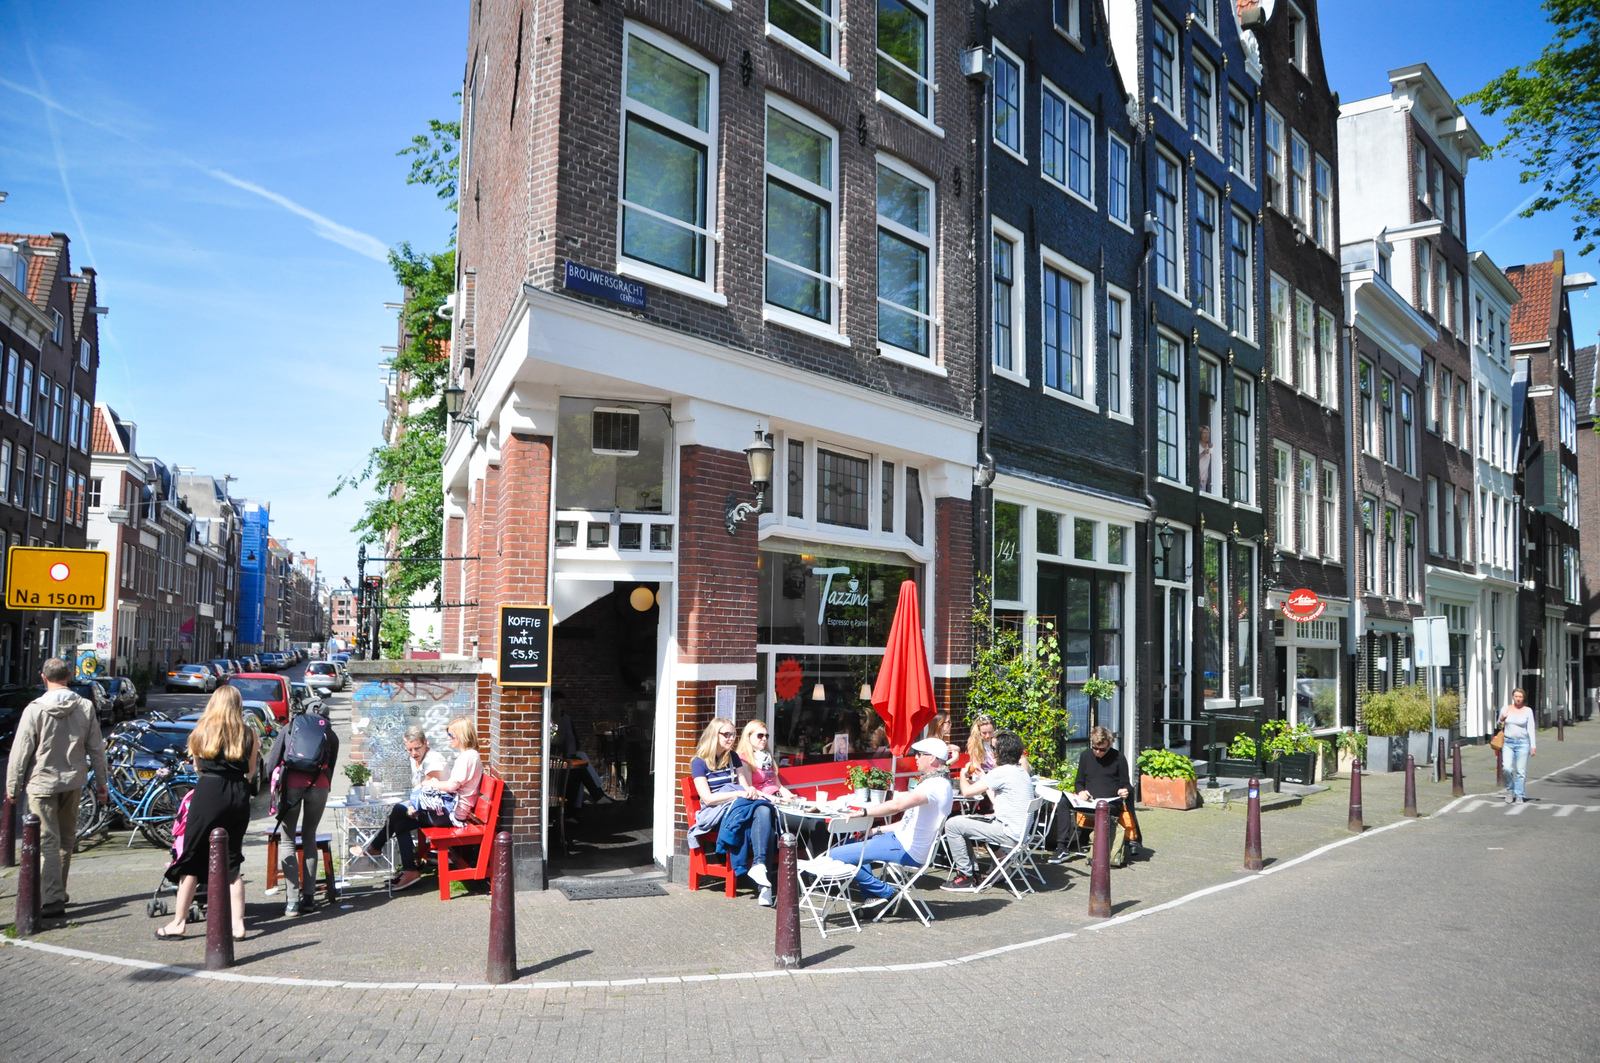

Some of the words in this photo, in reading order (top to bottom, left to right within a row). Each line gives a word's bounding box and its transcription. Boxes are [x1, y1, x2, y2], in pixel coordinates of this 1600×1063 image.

[568, 264, 644, 297] BROUWERSGRACHT
[619, 292, 644, 305] CENTRUM
[15, 589, 40, 604] Na
[812, 566, 869, 626] Tazzina
[507, 615, 541, 628] KOFFIE
[508, 635, 533, 646] TAART
[510, 648, 540, 660] €5,95
